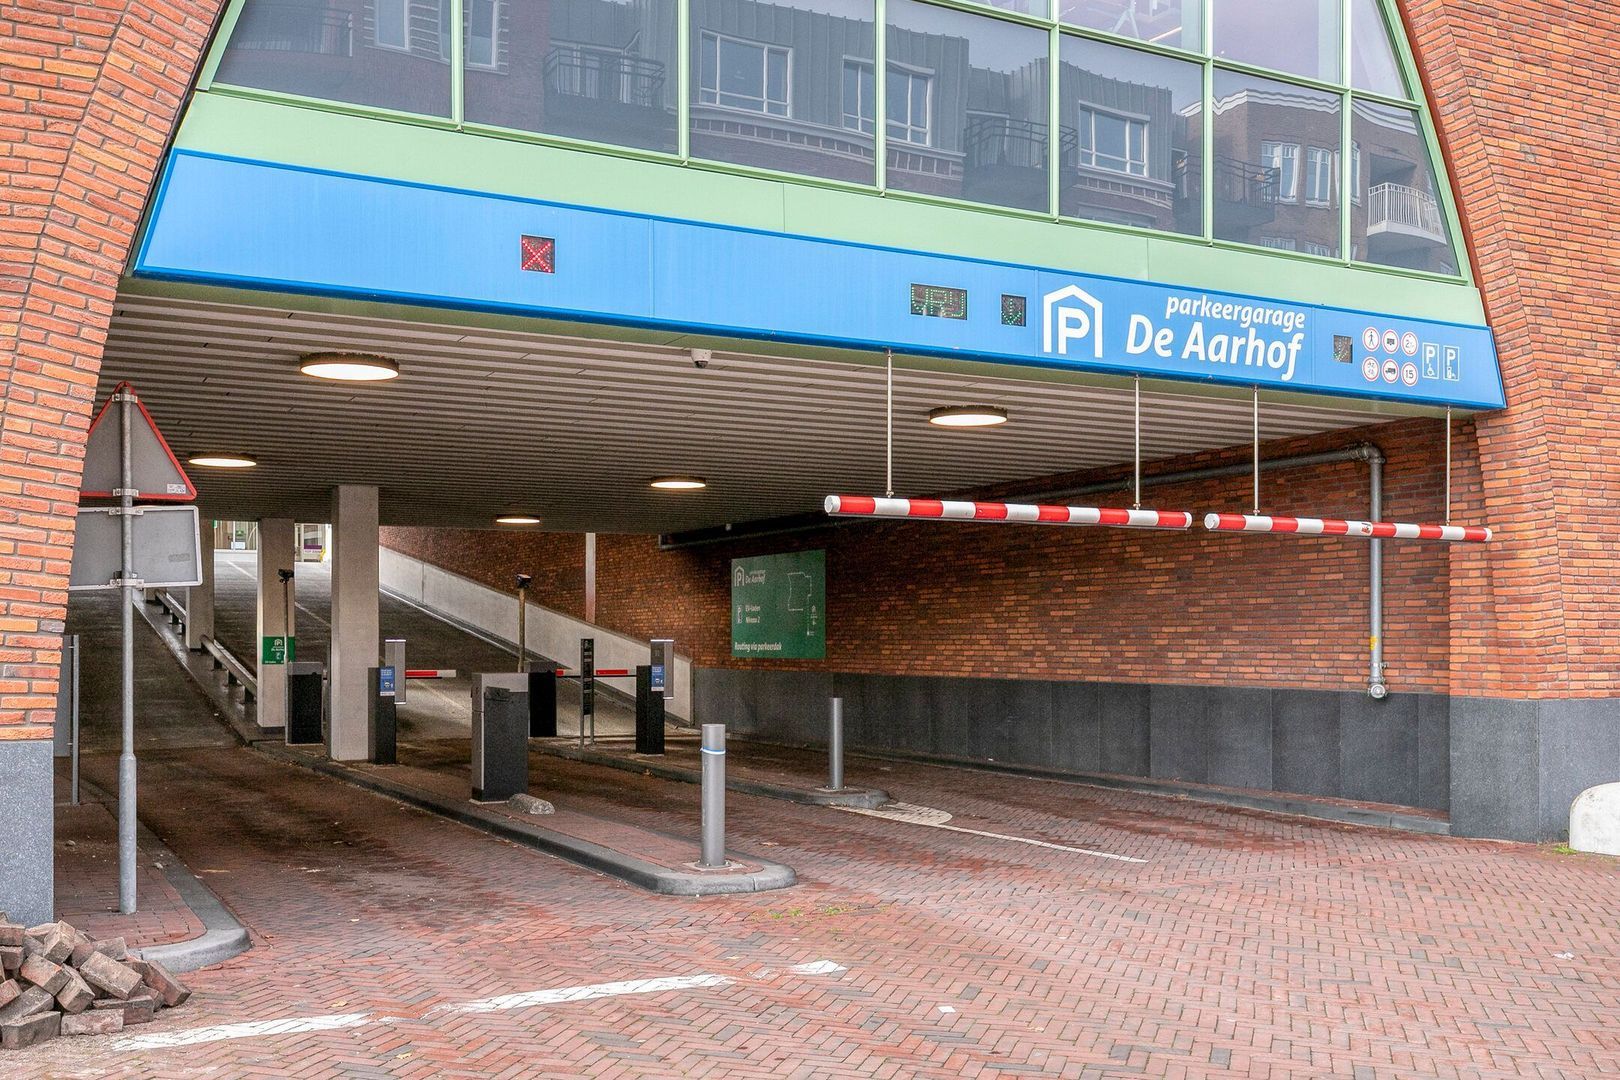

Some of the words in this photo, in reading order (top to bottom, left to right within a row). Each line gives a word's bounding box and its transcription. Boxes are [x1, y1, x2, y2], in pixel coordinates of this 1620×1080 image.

[1165, 294, 1306, 333] parkeergarage
[1126, 313, 1174, 358] De
[1181, 321, 1305, 381] Aarhof
[1426, 346, 1435, 364] P
[1447, 348, 1456, 366] P
[1405, 369, 1414, 379] 15
